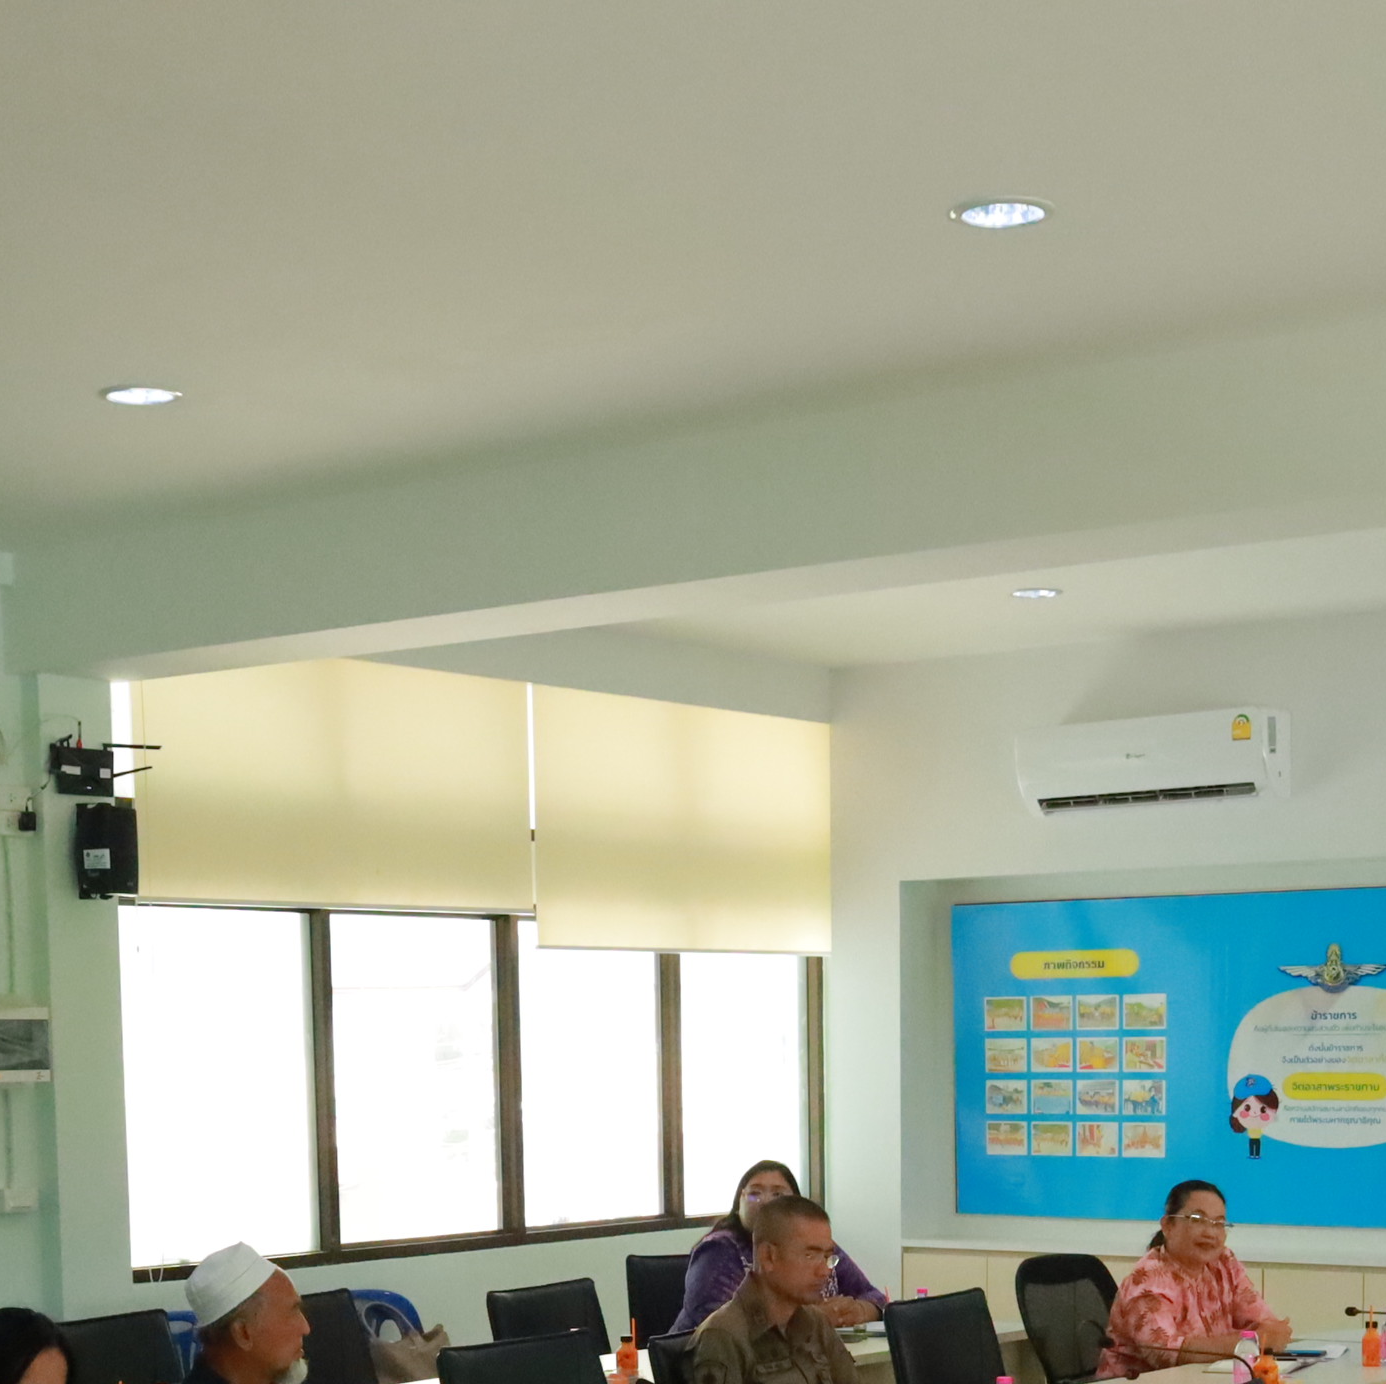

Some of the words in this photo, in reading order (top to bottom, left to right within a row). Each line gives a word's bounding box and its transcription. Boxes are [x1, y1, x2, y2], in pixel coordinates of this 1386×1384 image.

[1043, 959, 1105, 970] ภาพกิจกรรม
[1310, 1010, 1358, 1021] ข้าราชการ
[1292, 1082, 1380, 1092] จิตอาสาพระราชทาน
